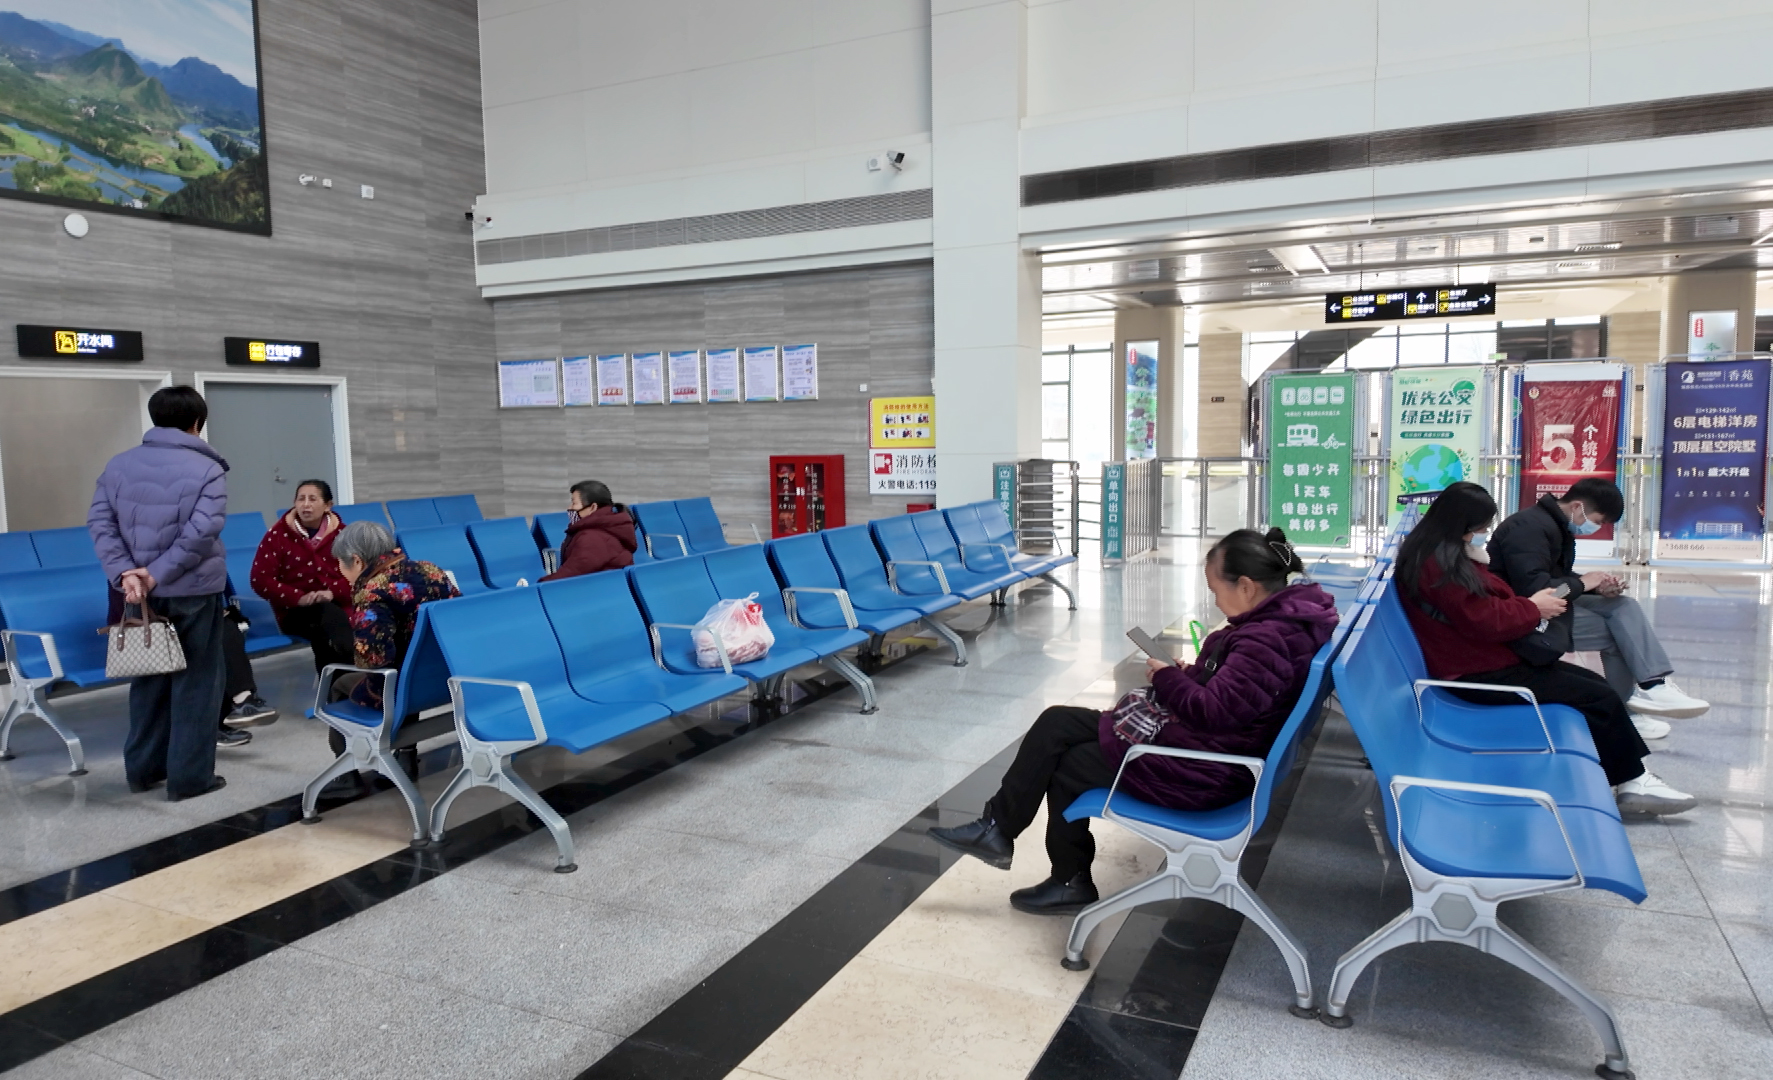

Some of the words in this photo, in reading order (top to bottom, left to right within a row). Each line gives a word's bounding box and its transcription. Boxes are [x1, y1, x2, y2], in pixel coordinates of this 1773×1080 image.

[77, 333, 114, 348] 开水间
[1728, 369, 1754, 381] 香苑
[1401, 390, 1473, 406] 优先公交
[1400, 409, 1473, 424] 绿色出行
[1673, 414, 1758, 429] 6层电梯洋房
[1541, 424, 1576, 471] 5
[1581, 424, 1599, 472] 个统筹
[1672, 440, 1757, 453] 顶层星空院墅
[1282, 463, 1340, 477] 每周少开
[1707, 466, 1750, 477] 盛大开盘
[878, 479, 936, 490] 火警电话:119
[1108, 480, 1119, 524] 单向出口
[1281, 502, 1339, 516] 绿色出行
[1288, 518, 1330, 532] 美好多
